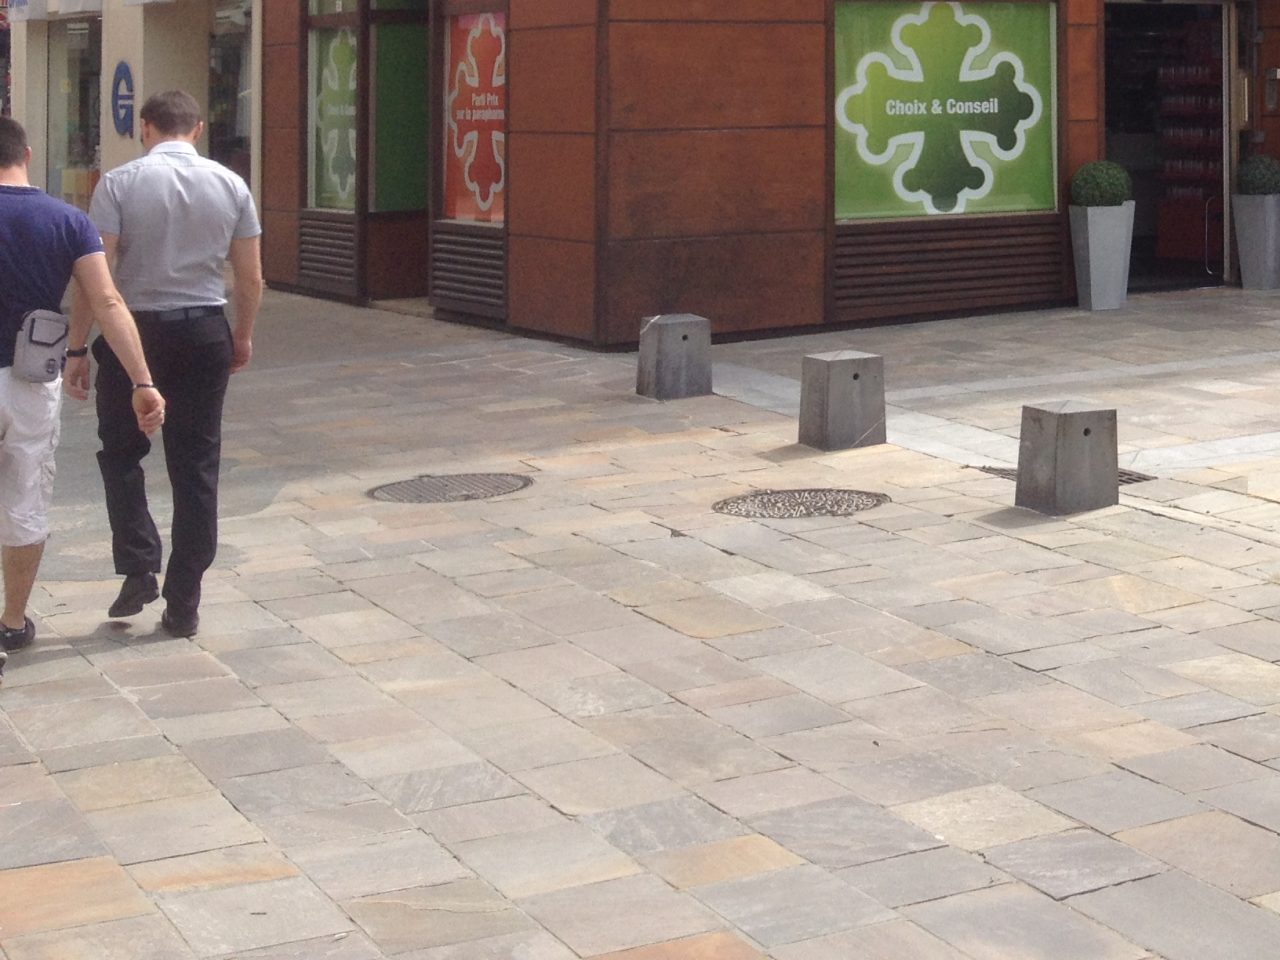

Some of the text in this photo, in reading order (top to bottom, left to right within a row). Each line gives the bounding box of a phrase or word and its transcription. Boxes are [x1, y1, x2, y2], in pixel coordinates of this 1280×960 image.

[885, 97, 999, 116] Choix & Conseil
